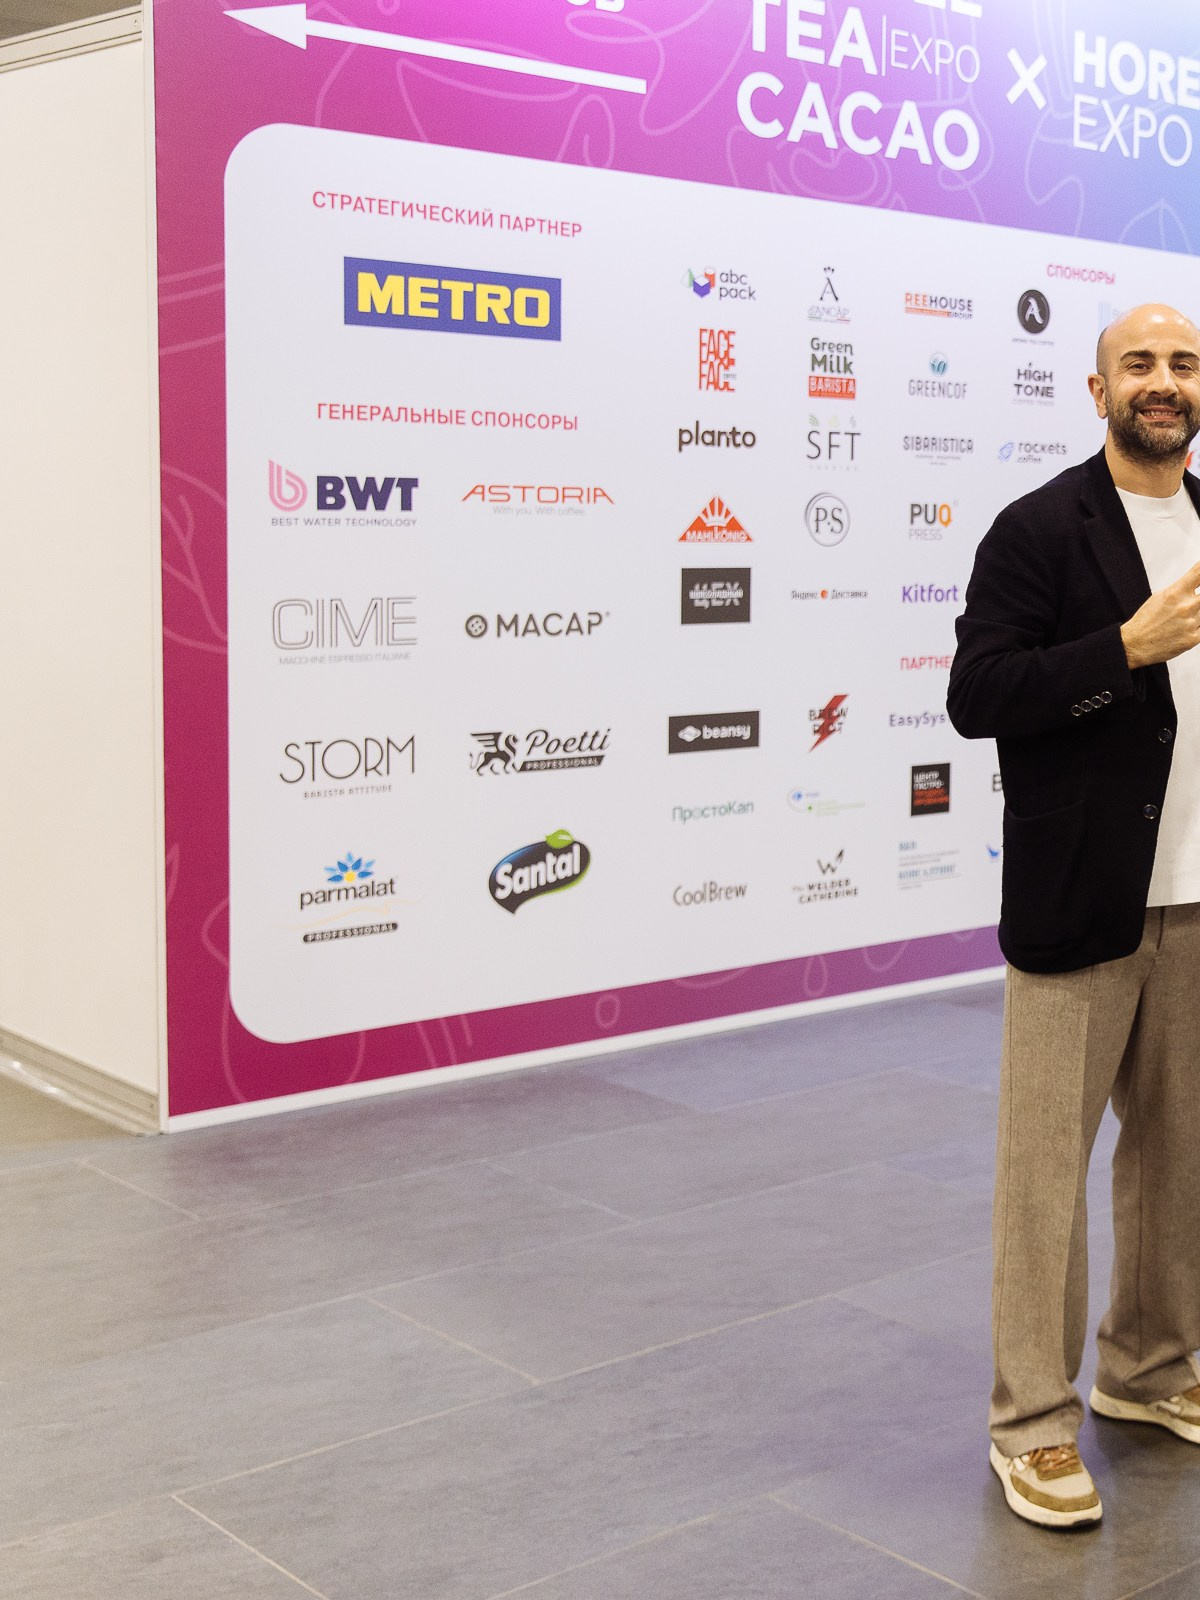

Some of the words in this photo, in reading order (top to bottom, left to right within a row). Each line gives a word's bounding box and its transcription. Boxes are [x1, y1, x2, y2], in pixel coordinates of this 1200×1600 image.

[751, 0, 878, 76] TEA
[890, 30, 981, 84] EXPO
[737, 71, 980, 171] CACAO
[1073, 93, 1193, 167] EXPO
[312, 190, 494, 228] СТРАТЕГИЧЕСКИЙ
[499, 213, 583, 238] ПАРТНЕР
[719, 270, 748, 286] abc
[1046, 264, 1116, 285] СПОНСОРЫ
[357, 271, 550, 328] METRO
[719, 286, 757, 300] pack
[699, 328, 736, 366] FACE
[811, 337, 854, 355] Green
[811, 353, 854, 375] Milk
[809, 377, 855, 394] BARISTA
[1017, 368, 1053, 382] HIGH
[1014, 384, 1054, 398] TONE
[317, 402, 466, 426] ГЕНЕРАЛЬНЫЕ
[471, 411, 579, 431] СПОНСОРЫ
[679, 420, 756, 453] planto
[806, 430, 862, 461] SFT
[903, 435, 974, 454] SIBARISTICA
[1018, 442, 1068, 456] rockets
[316, 475, 419, 512] BWT
[462, 484, 615, 505] ASTORIA
[492, 505, 514, 517] With
[535, 507, 556, 517] With
[910, 503, 952, 527] PUQ
[271, 517, 299, 527] BEST
[304, 517, 341, 527] WATER
[345, 518, 418, 528] TECHNOLOGY
[909, 529, 943, 541] PRESS
[902, 584, 958, 602] Kitfort
[272, 597, 418, 651] CIME
[497, 612, 603, 638] MACAP
[900, 656, 954, 670] ПАРТНЕ
[889, 713, 949, 728] EasySys
[702, 724, 751, 740] beansy
[526, 728, 612, 758] Poetti
[280, 735, 416, 784] STORM
[526, 758, 600, 770] PROFESSIONAL
[304, 789, 345, 800] BARISTA
[349, 785, 392, 796] ATTITUDE
[672, 802, 754, 823] ПростоКап
[494, 844, 582, 900] Santal
[299, 876, 396, 911] parmalat
[673, 881, 748, 905] CoolBrew
[306, 924, 396, 942] PROFESSIONAL
